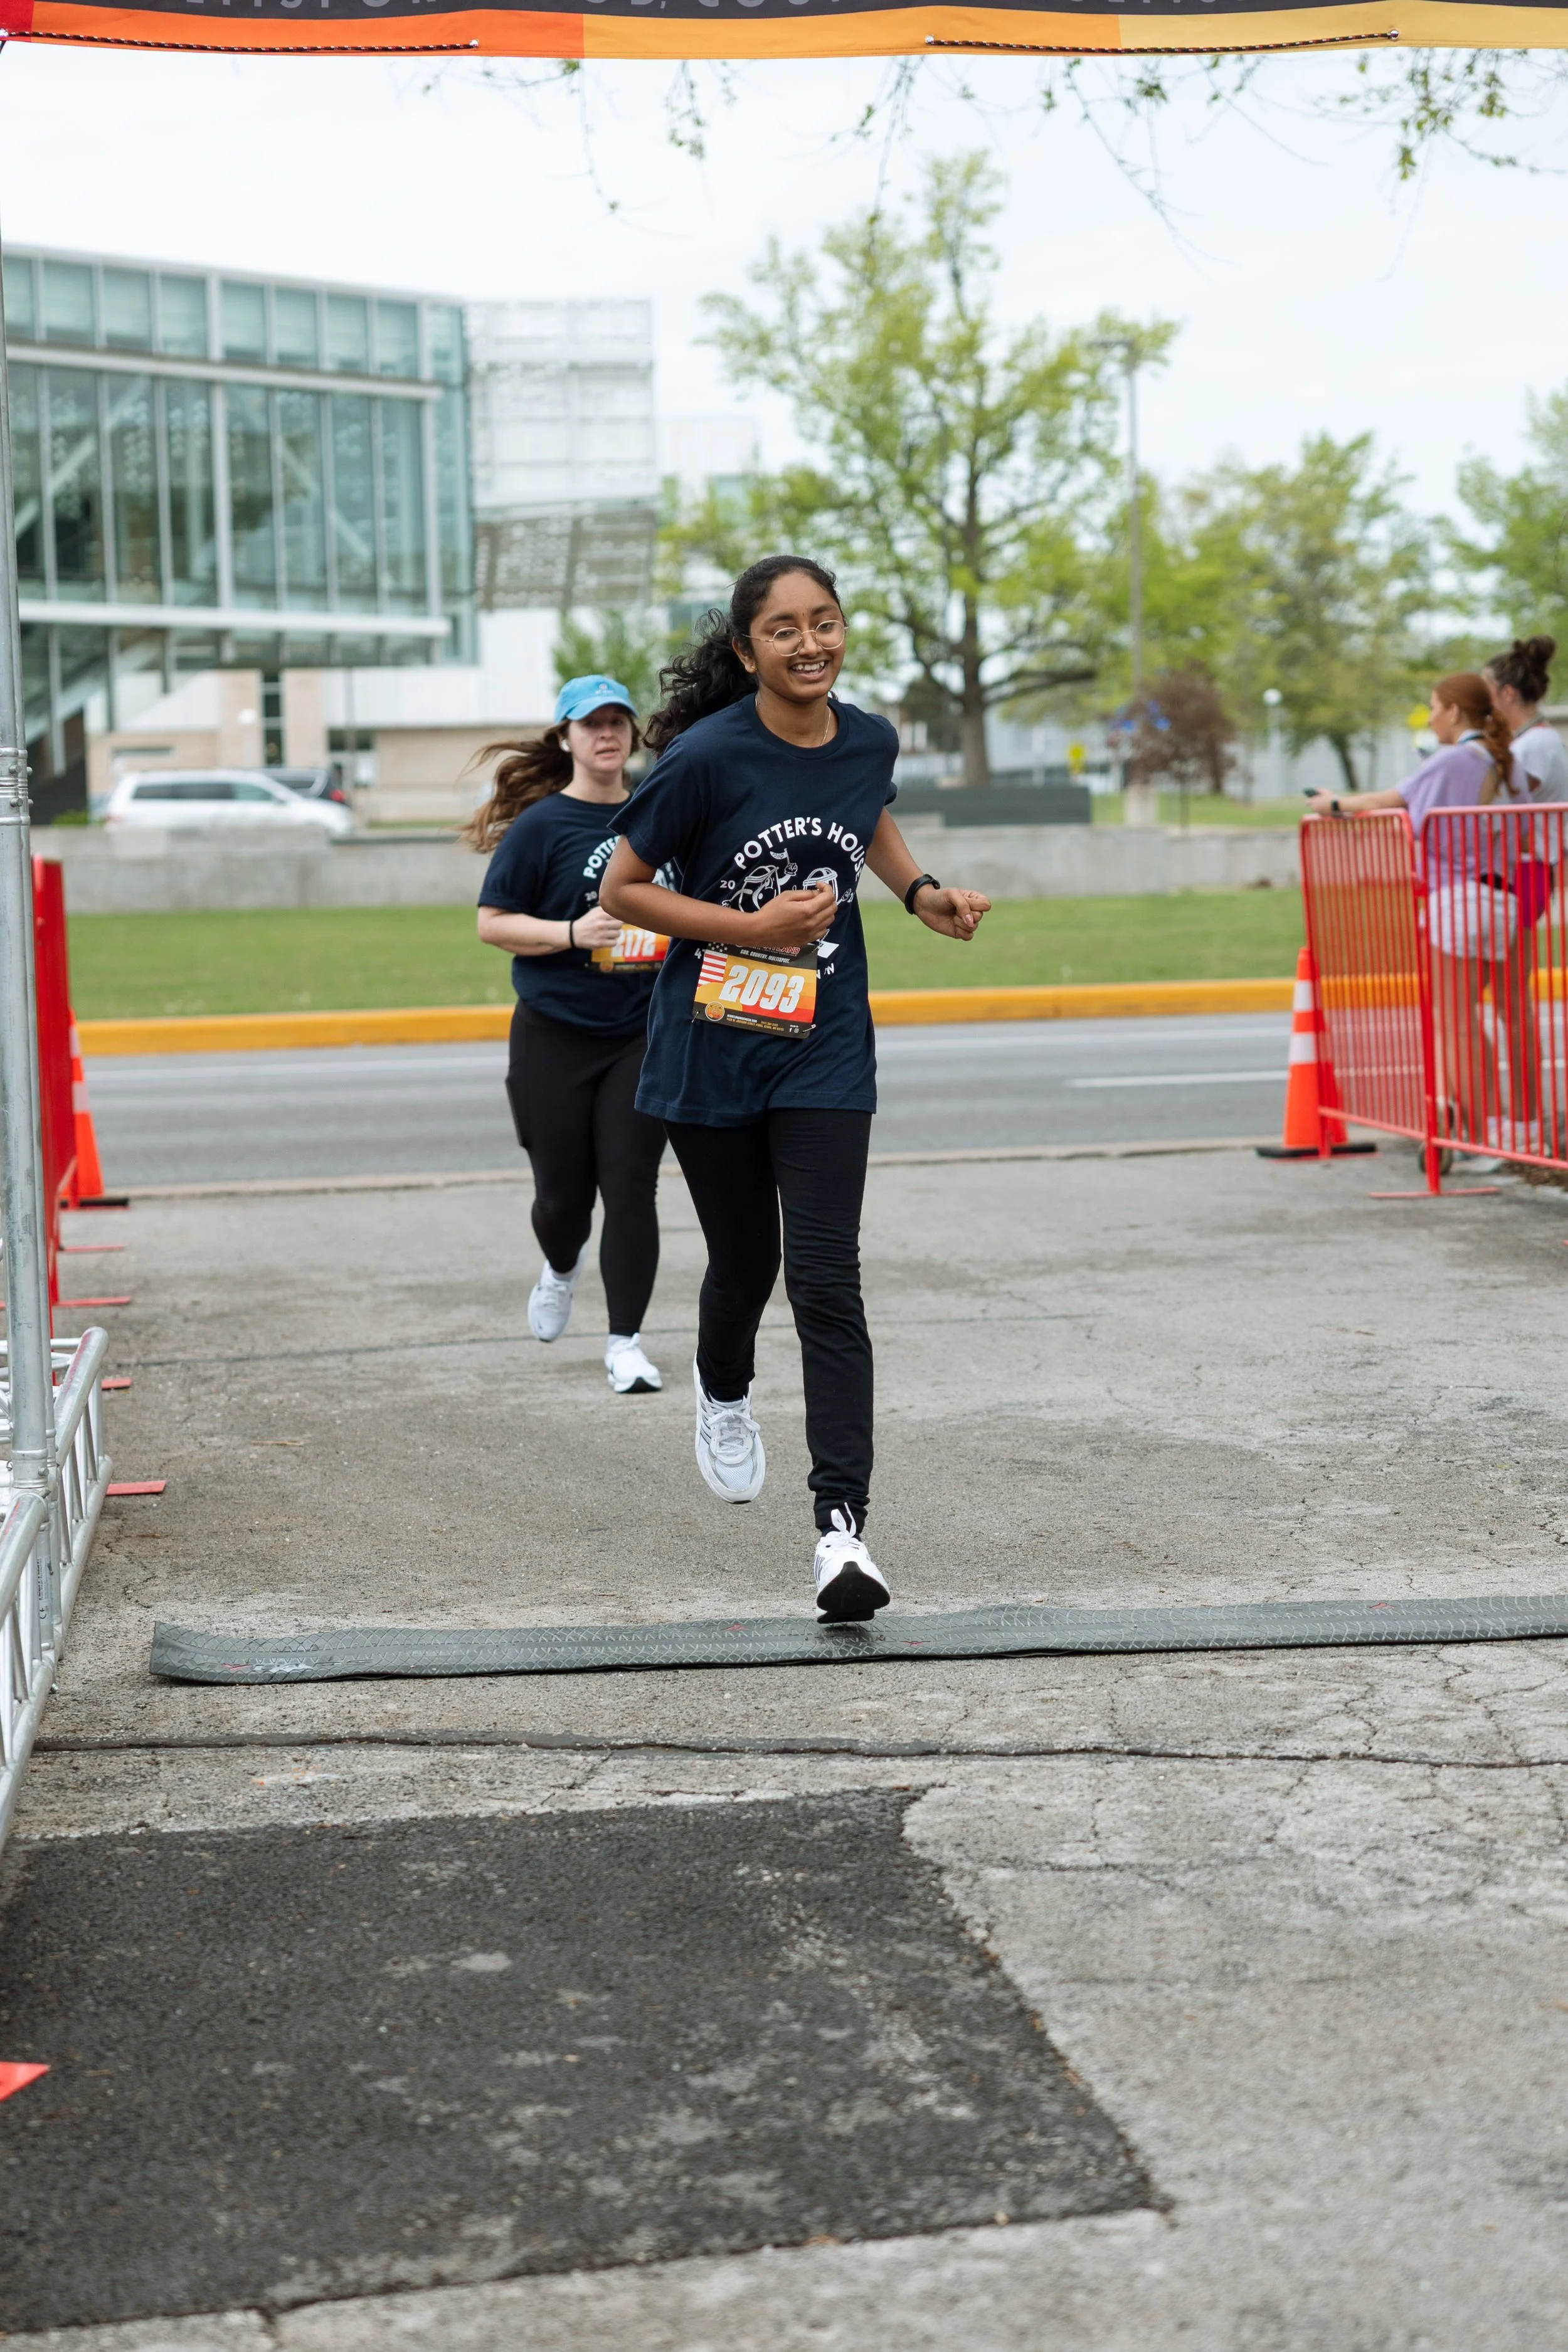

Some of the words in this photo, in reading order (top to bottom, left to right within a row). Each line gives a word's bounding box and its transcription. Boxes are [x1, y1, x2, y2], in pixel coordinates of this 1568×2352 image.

[734, 817, 822, 869] POTTER'S
[719, 880, 736, 890] 20
[718, 965, 805, 1014] 2093
